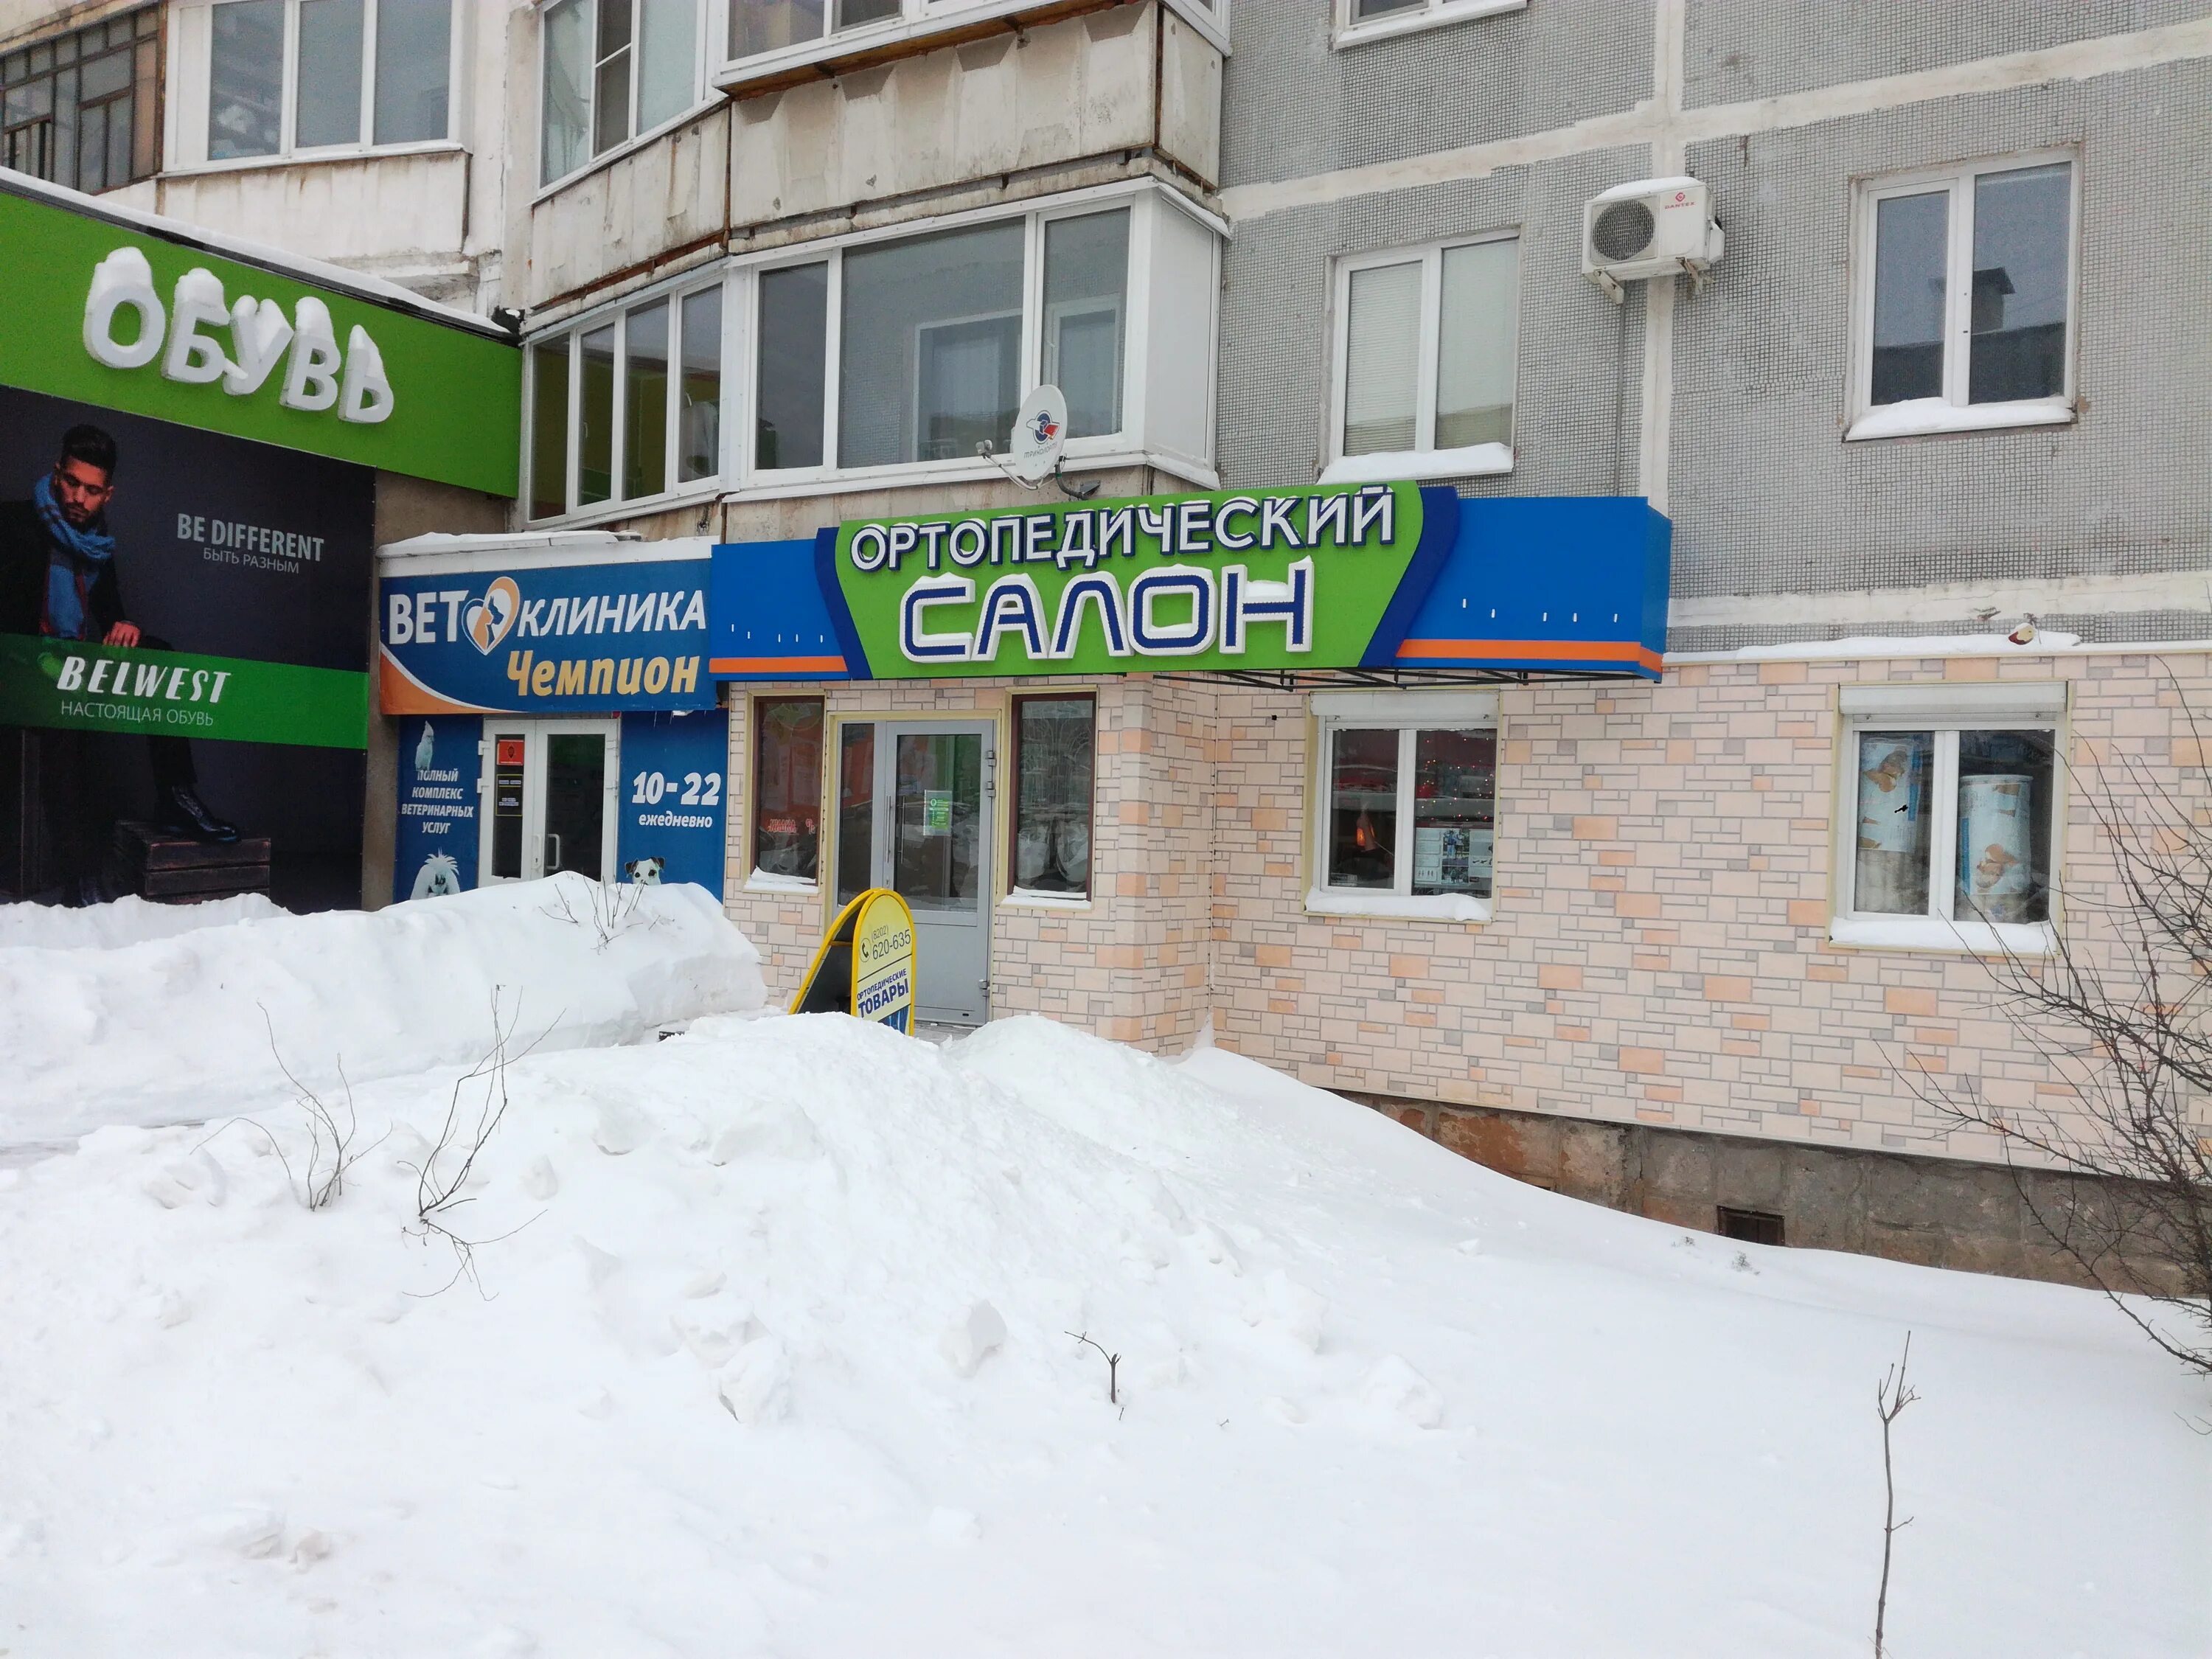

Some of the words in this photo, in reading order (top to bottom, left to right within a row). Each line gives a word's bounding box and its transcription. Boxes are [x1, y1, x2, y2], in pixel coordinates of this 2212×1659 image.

[1664, 201, 1695, 209] DANTEX
[83, 247, 394, 423] ОБУВЬ
[178, 513, 206, 542] BE
[211, 519, 324, 561] DIFFERENT
[850, 484, 1396, 572] ОРТОПЕДИЧЕСКИЙ
[204, 547, 240, 564] БЫТЬ
[243, 554, 299, 574] РАЗНЫМ
[389, 590, 469, 645] ВЕТ
[517, 590, 706, 637] КЛИНИКА
[899, 556, 1314, 664] САЛОН
[57, 655, 232, 703] BELWEST
[507, 650, 700, 696] Чемпион
[61, 701, 161, 723] НАСТОЯЩАЯ
[167, 709, 214, 726] ОБУВЬ
[417, 768, 459, 782] ПОЛНЫЙ
[632, 771, 721, 806] 10-22
[411, 787, 464, 799] КОМПЛЕКС
[401, 803, 474, 818] ВЕТЕРИНАРНЫХ
[639, 810, 712, 828] ежедневно
[422, 821, 451, 834] УСЛУГ
[871, 924, 888, 942] (8202)
[873, 929, 911, 960] 620-635
[857, 968, 907, 1001] ОРТОПЕДИЧЕСКИЕ
[858, 978, 908, 1018] ТОВАРЫ
